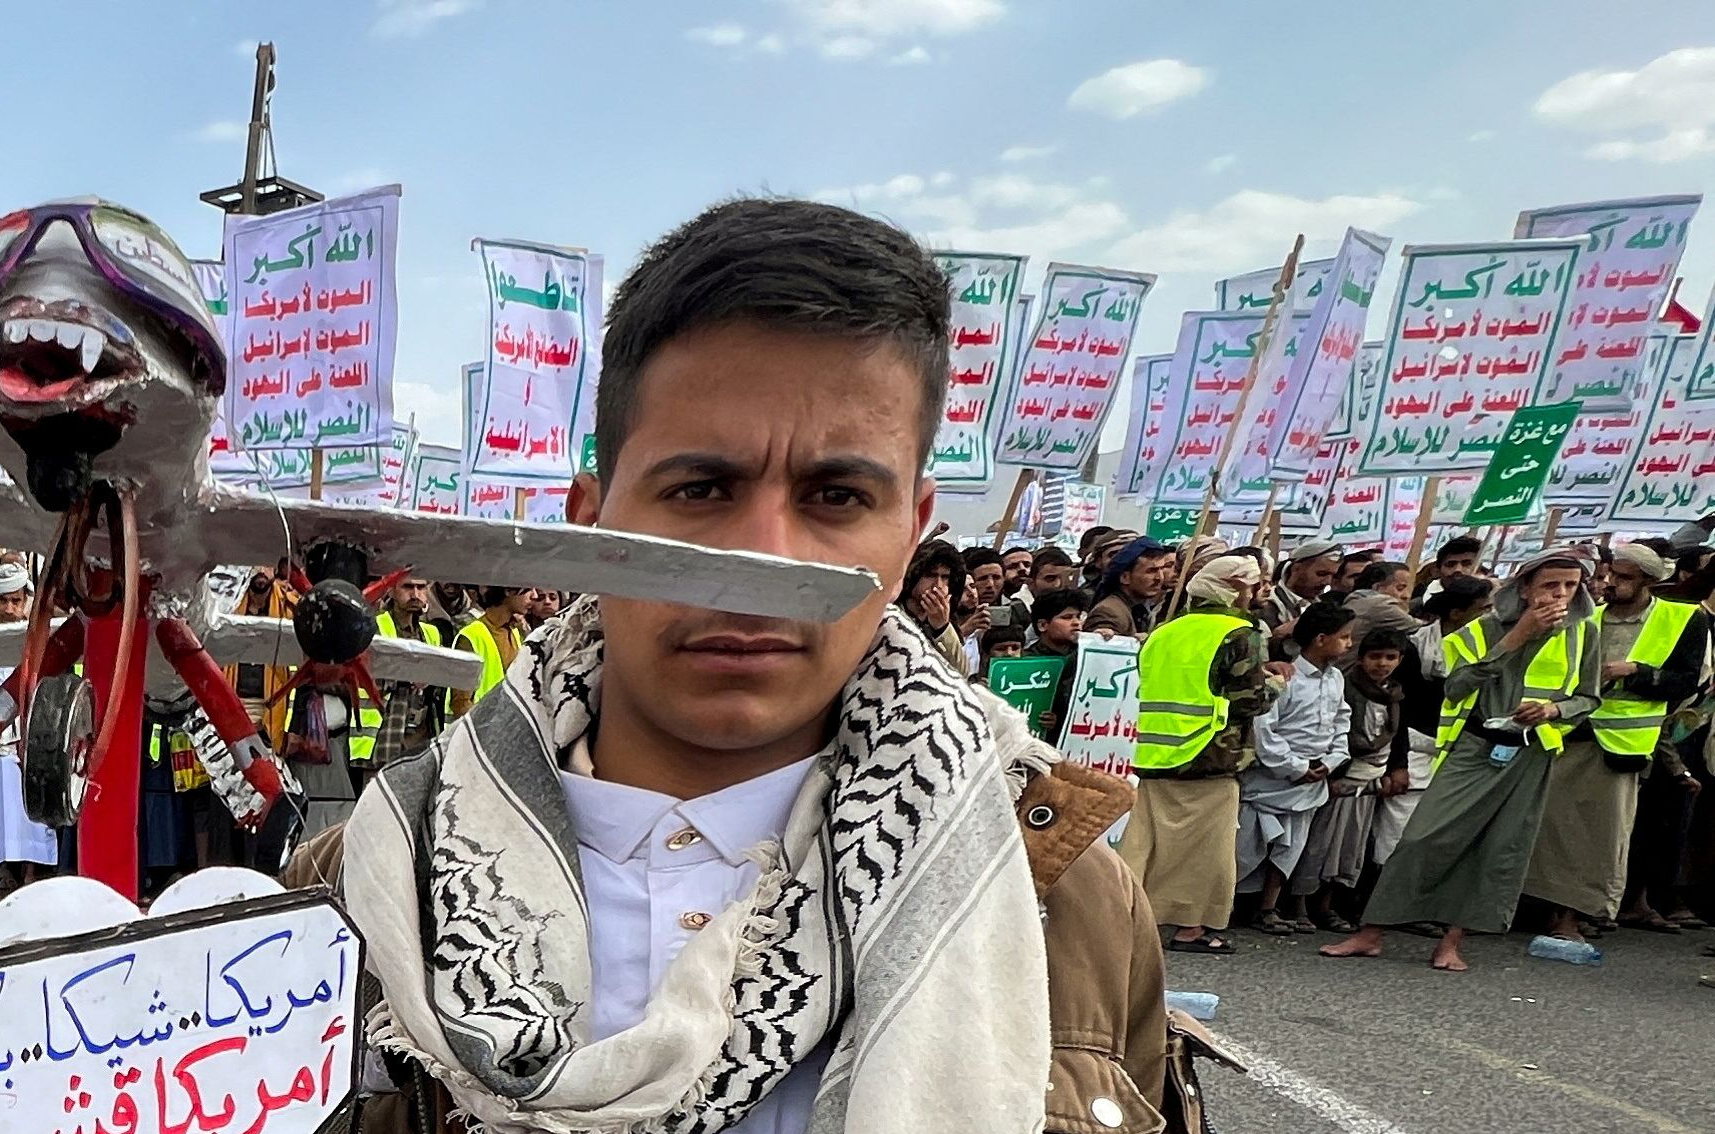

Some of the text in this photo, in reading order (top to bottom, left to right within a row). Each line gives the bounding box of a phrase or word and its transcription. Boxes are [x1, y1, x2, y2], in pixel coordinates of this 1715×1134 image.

[1625, 216, 1690, 249] الله
[244, 222, 373, 285] الله أكبر
[491, 260, 579, 313] قاطعوا
[957, 267, 1010, 306] الله
[1408, 255, 1509, 311] أكبر
[1504, 260, 1565, 297] الله
[1604, 263, 1674, 292] الموت
[245, 281, 313, 321] لأمريكا
[317, 280, 372, 314] الموت
[1047, 283, 1136, 325] الله أكبر
[243, 319, 370, 362] الموت لإسرائيل
[1402, 308, 1482, 344] لأمريكا
[1485, 311, 1552, 342] الموت
[1033, 327, 1127, 358] الموت لأمريكا
[1596, 336, 1646, 359] اللعنة
[243, 361, 369, 401] اللعنة على اليهود
[1024, 361, 1116, 391] الموت لإسرائيل
[1392, 350, 1541, 383] الموت لإسرائيل
[523, 376, 532, 407] و
[1385, 389, 1441, 420] اليهود
[1443, 390, 1475, 418] على
[1481, 387, 1530, 412] اللعنة
[309, 400, 372, 447] النصر
[1017, 397, 1104, 422] اللعنة على اليهود
[242, 407, 308, 447] للإسلام
[485, 416, 565, 462] الإسرائيلية
[1005, 425, 1090, 459] النصر للإسلام
[1508, 420, 1567, 445] مع غزة
[1176, 436, 1223, 461] اليهود
[1370, 425, 1451, 464] للإسلام
[1561, 438, 1633, 460] اللعنة على
[1499, 454, 1540, 480] حتى
[1565, 461, 1625, 491] النصر
[1636, 453, 1691, 478] اليهود
[420, 472, 460, 495] كبر
[1342, 484, 1382, 504] اللعنة
[1472, 486, 1535, 513] النصر
[1620, 481, 1698, 517] للإسلام
[1325, 509, 1380, 541] النصر
[999, 665, 1052, 693] شكراً
[1078, 658, 1139, 707] أكبر
[1069, 708, 1122, 741] لأمريكا
